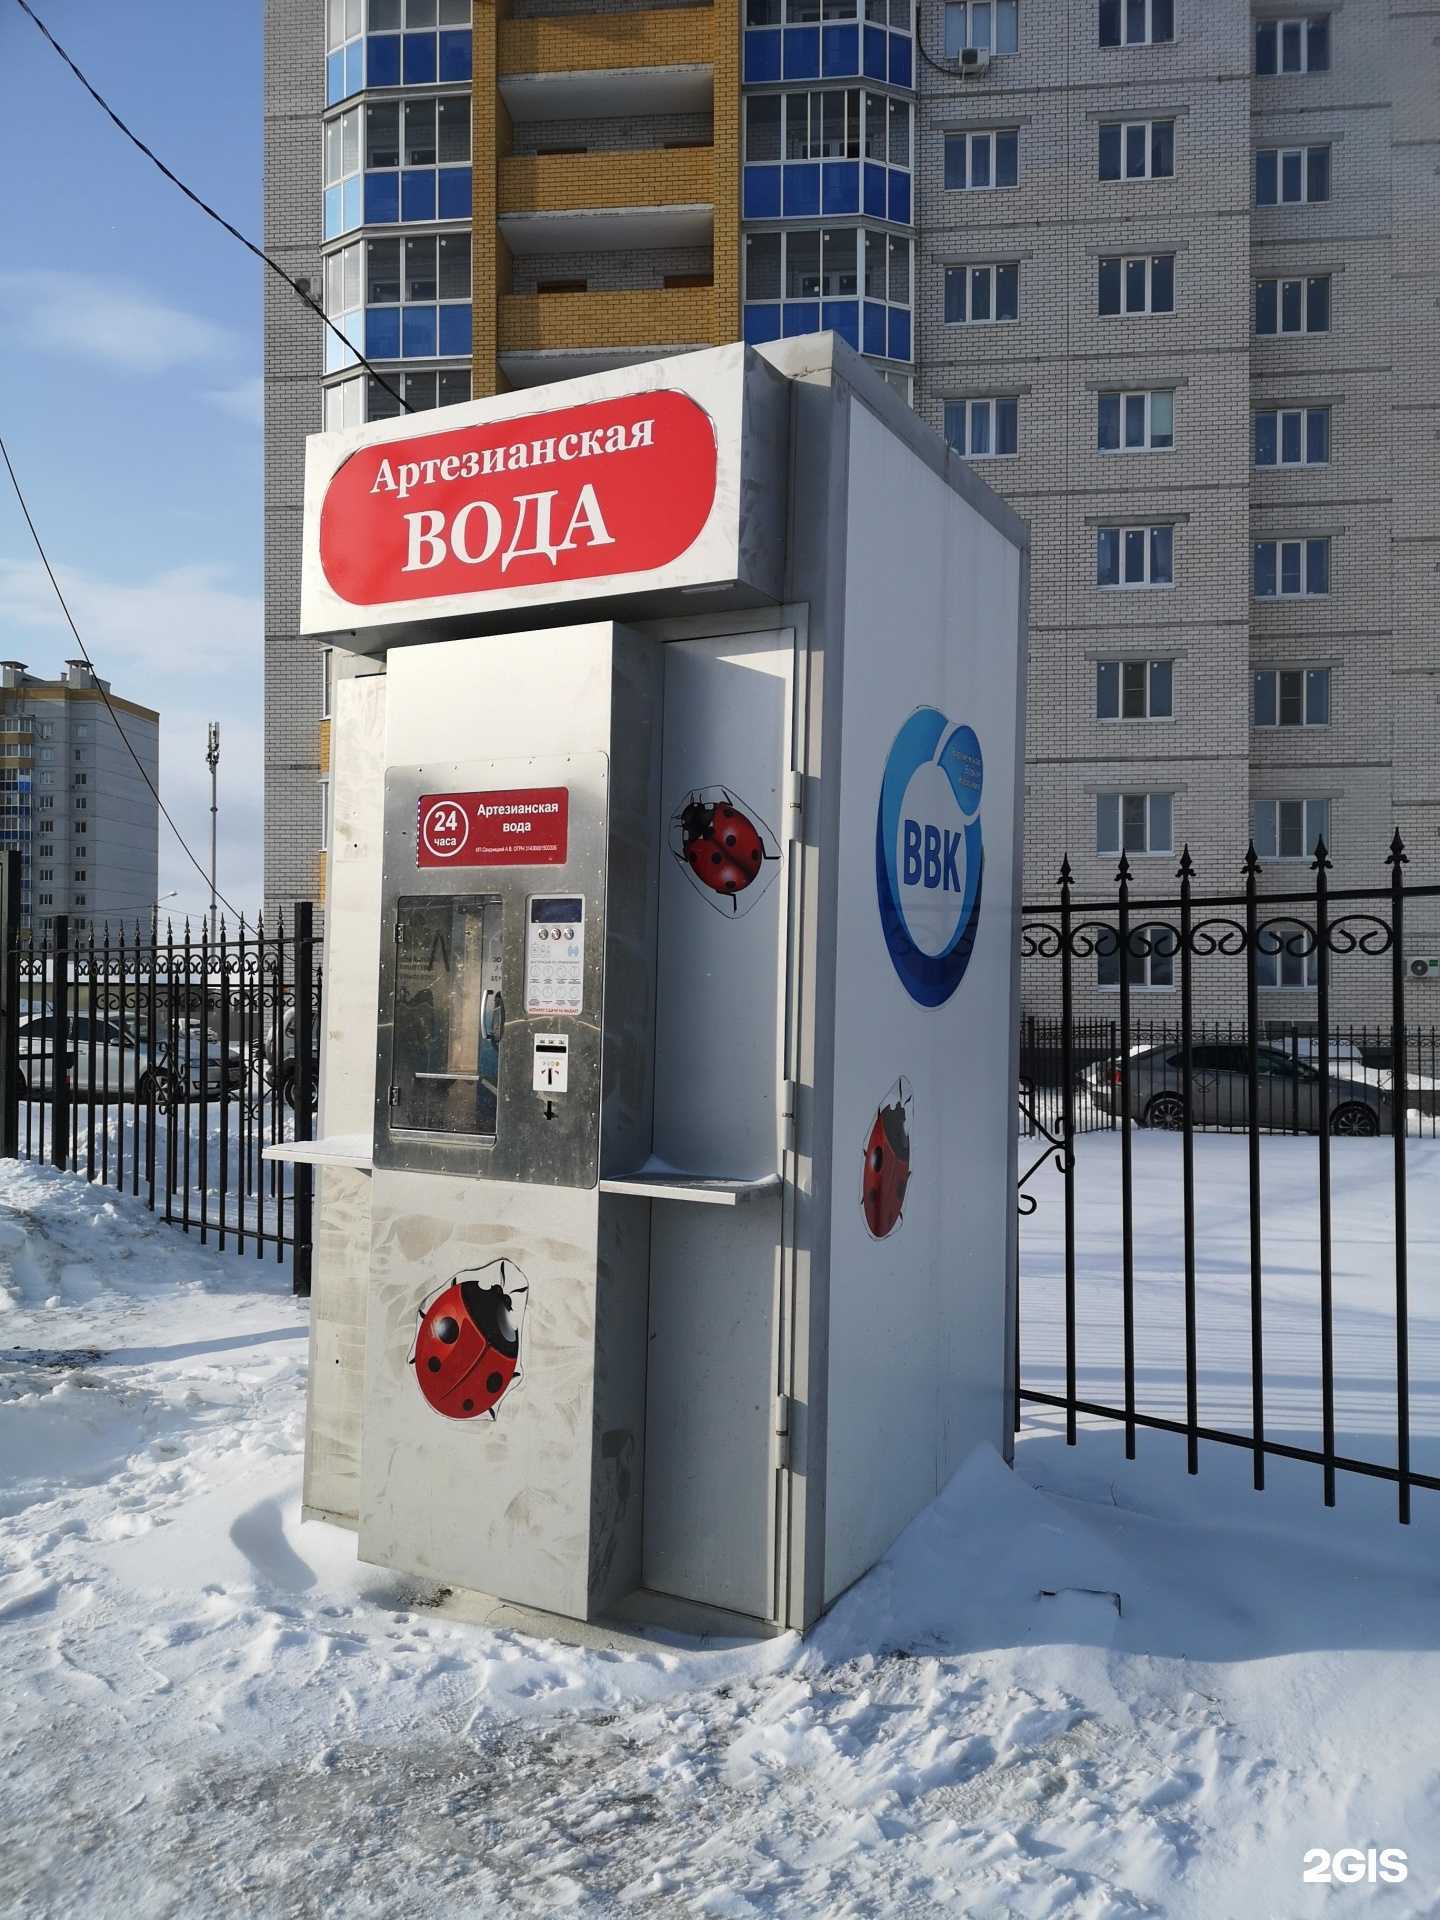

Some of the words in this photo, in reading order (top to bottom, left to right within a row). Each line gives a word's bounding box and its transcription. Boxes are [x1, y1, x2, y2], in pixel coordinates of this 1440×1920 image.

[369, 418, 655, 499] Артезианская
[401, 483, 615, 573] ВОДА
[477, 803, 558, 817] Артезианская
[434, 811, 457, 832] 24
[503, 822, 531, 834] вода
[434, 837, 456, 846] часа
